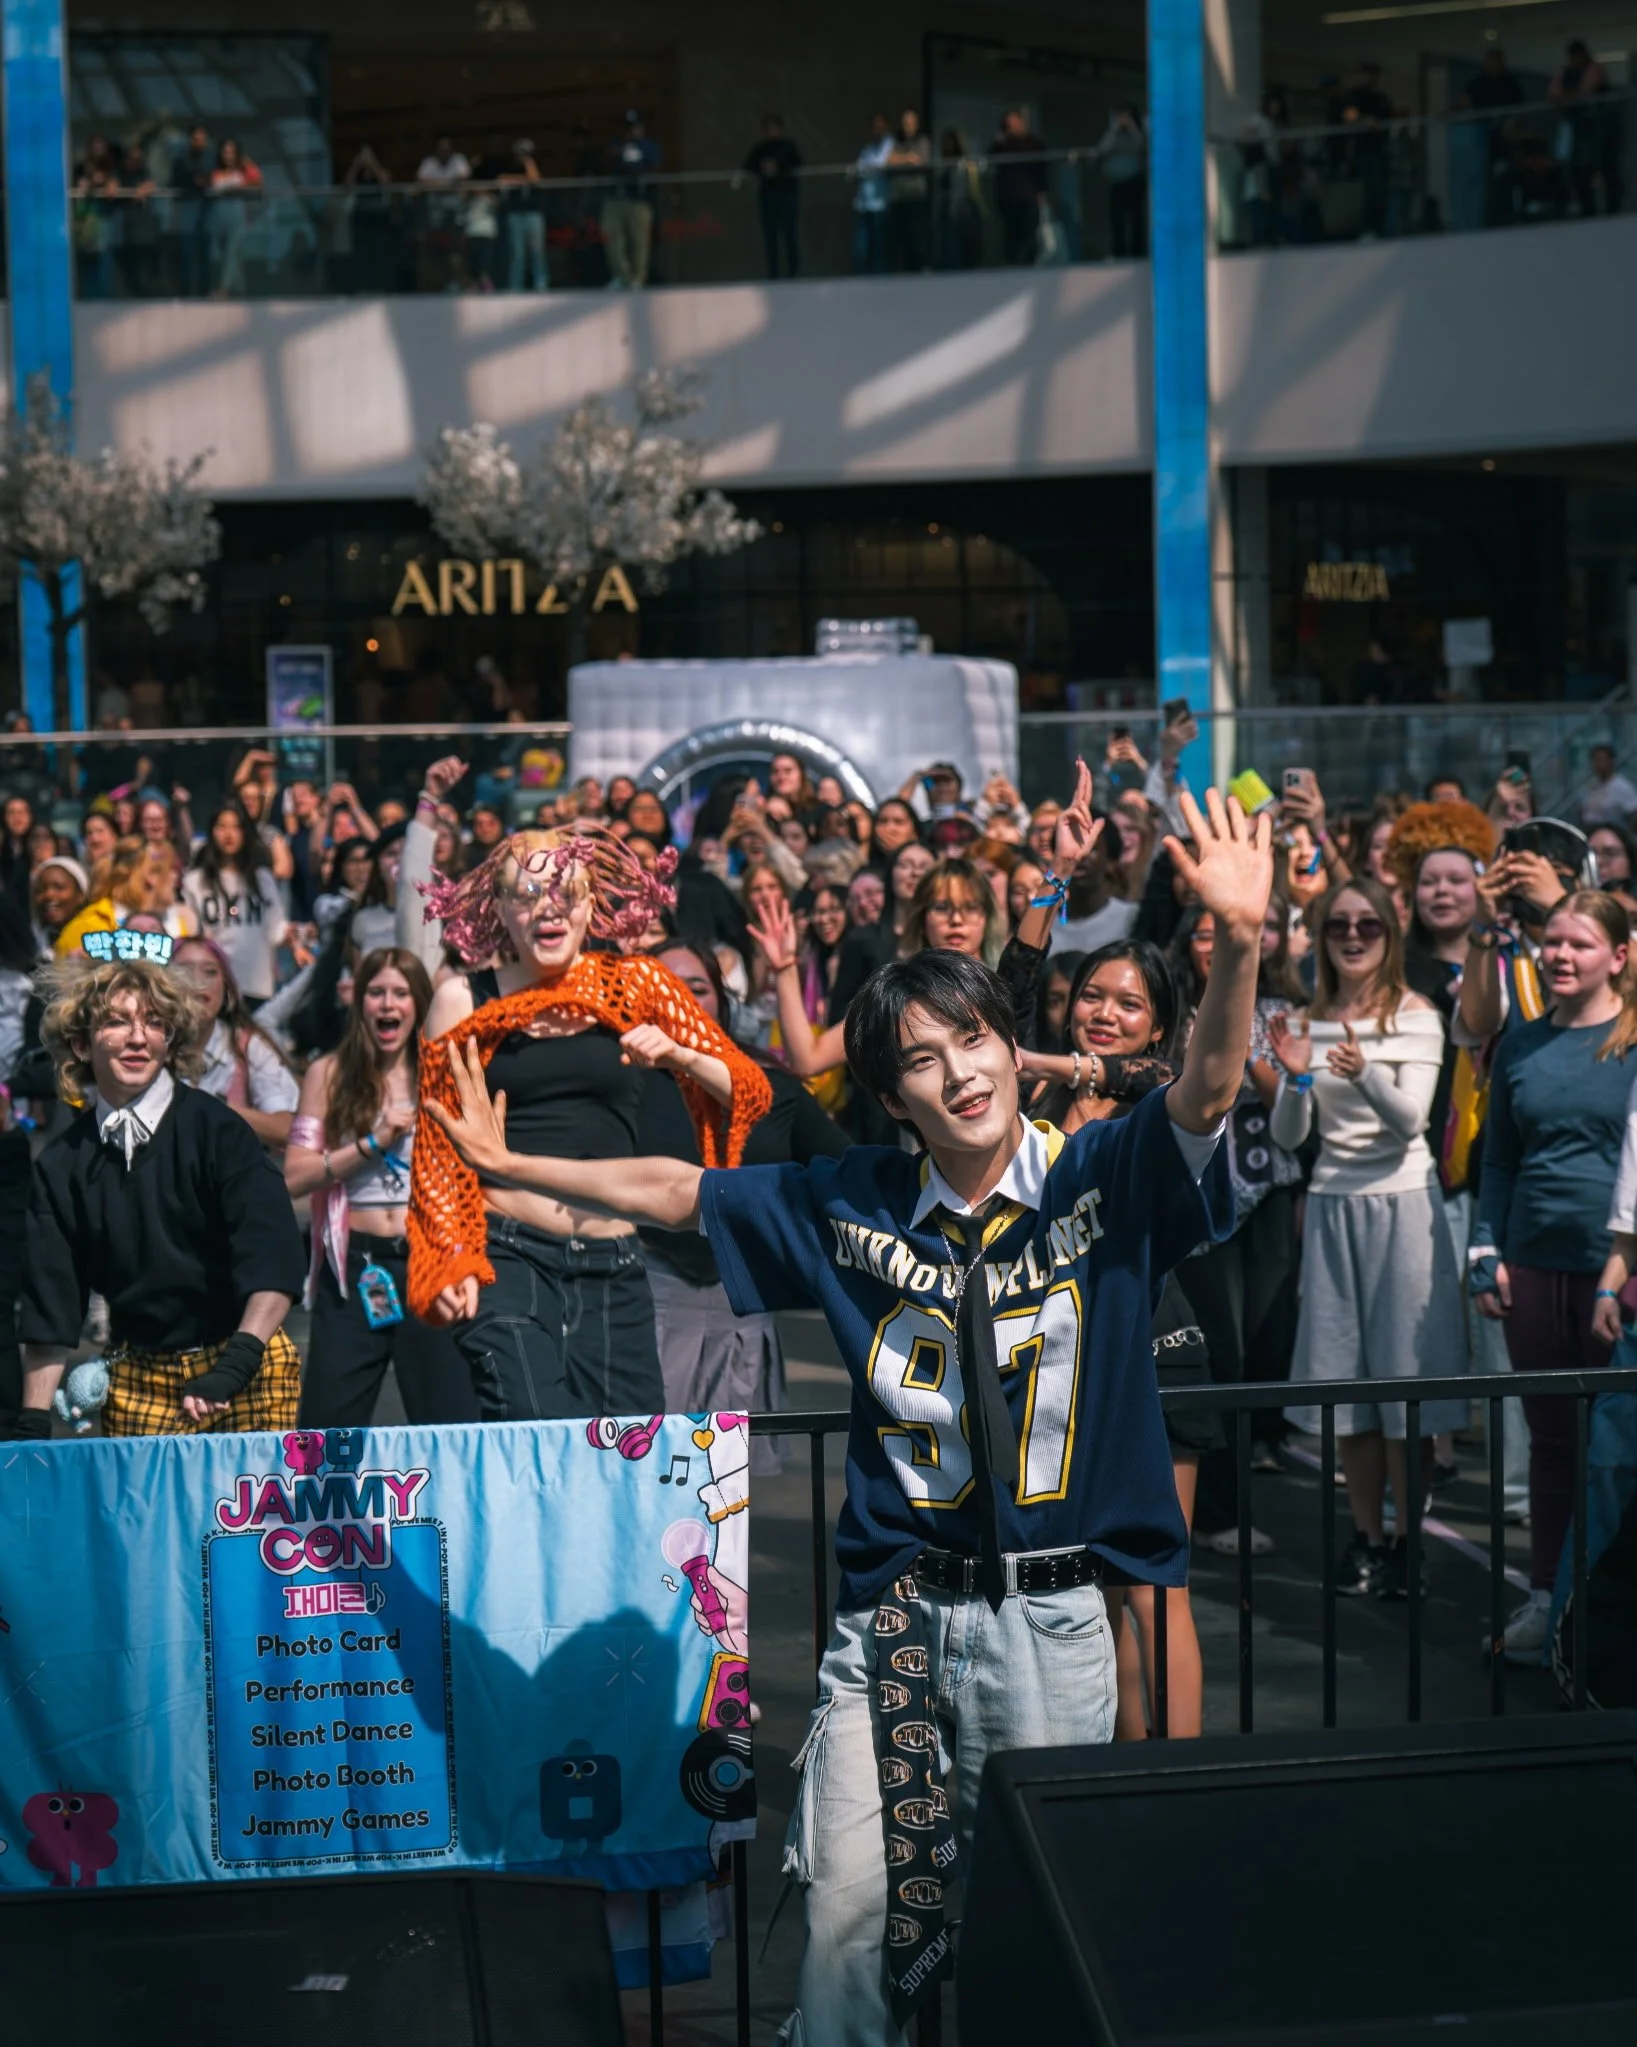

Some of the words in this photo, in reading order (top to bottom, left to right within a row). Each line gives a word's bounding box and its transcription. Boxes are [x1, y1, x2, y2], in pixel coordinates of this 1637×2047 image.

[392, 559, 638, 615] ARITZA
[83, 930, 174, 965] 박한빈
[867, 1279, 1082, 1509] 97
[217, 1471, 428, 1529] JAMMY
[261, 1523, 388, 1571] CON
[284, 1584, 366, 1617] 재미콘
[256, 1634, 333, 1657] Photo
[339, 1628, 401, 1653] Card
[245, 1677, 415, 1703] Performance
[251, 1723, 326, 1747] Silent
[332, 1720, 413, 1743] Dance
[253, 1769, 331, 1792] Photo
[337, 1761, 415, 1786] Booth
[241, 1814, 334, 1839] Jammy
[342, 1809, 430, 1830] Games
